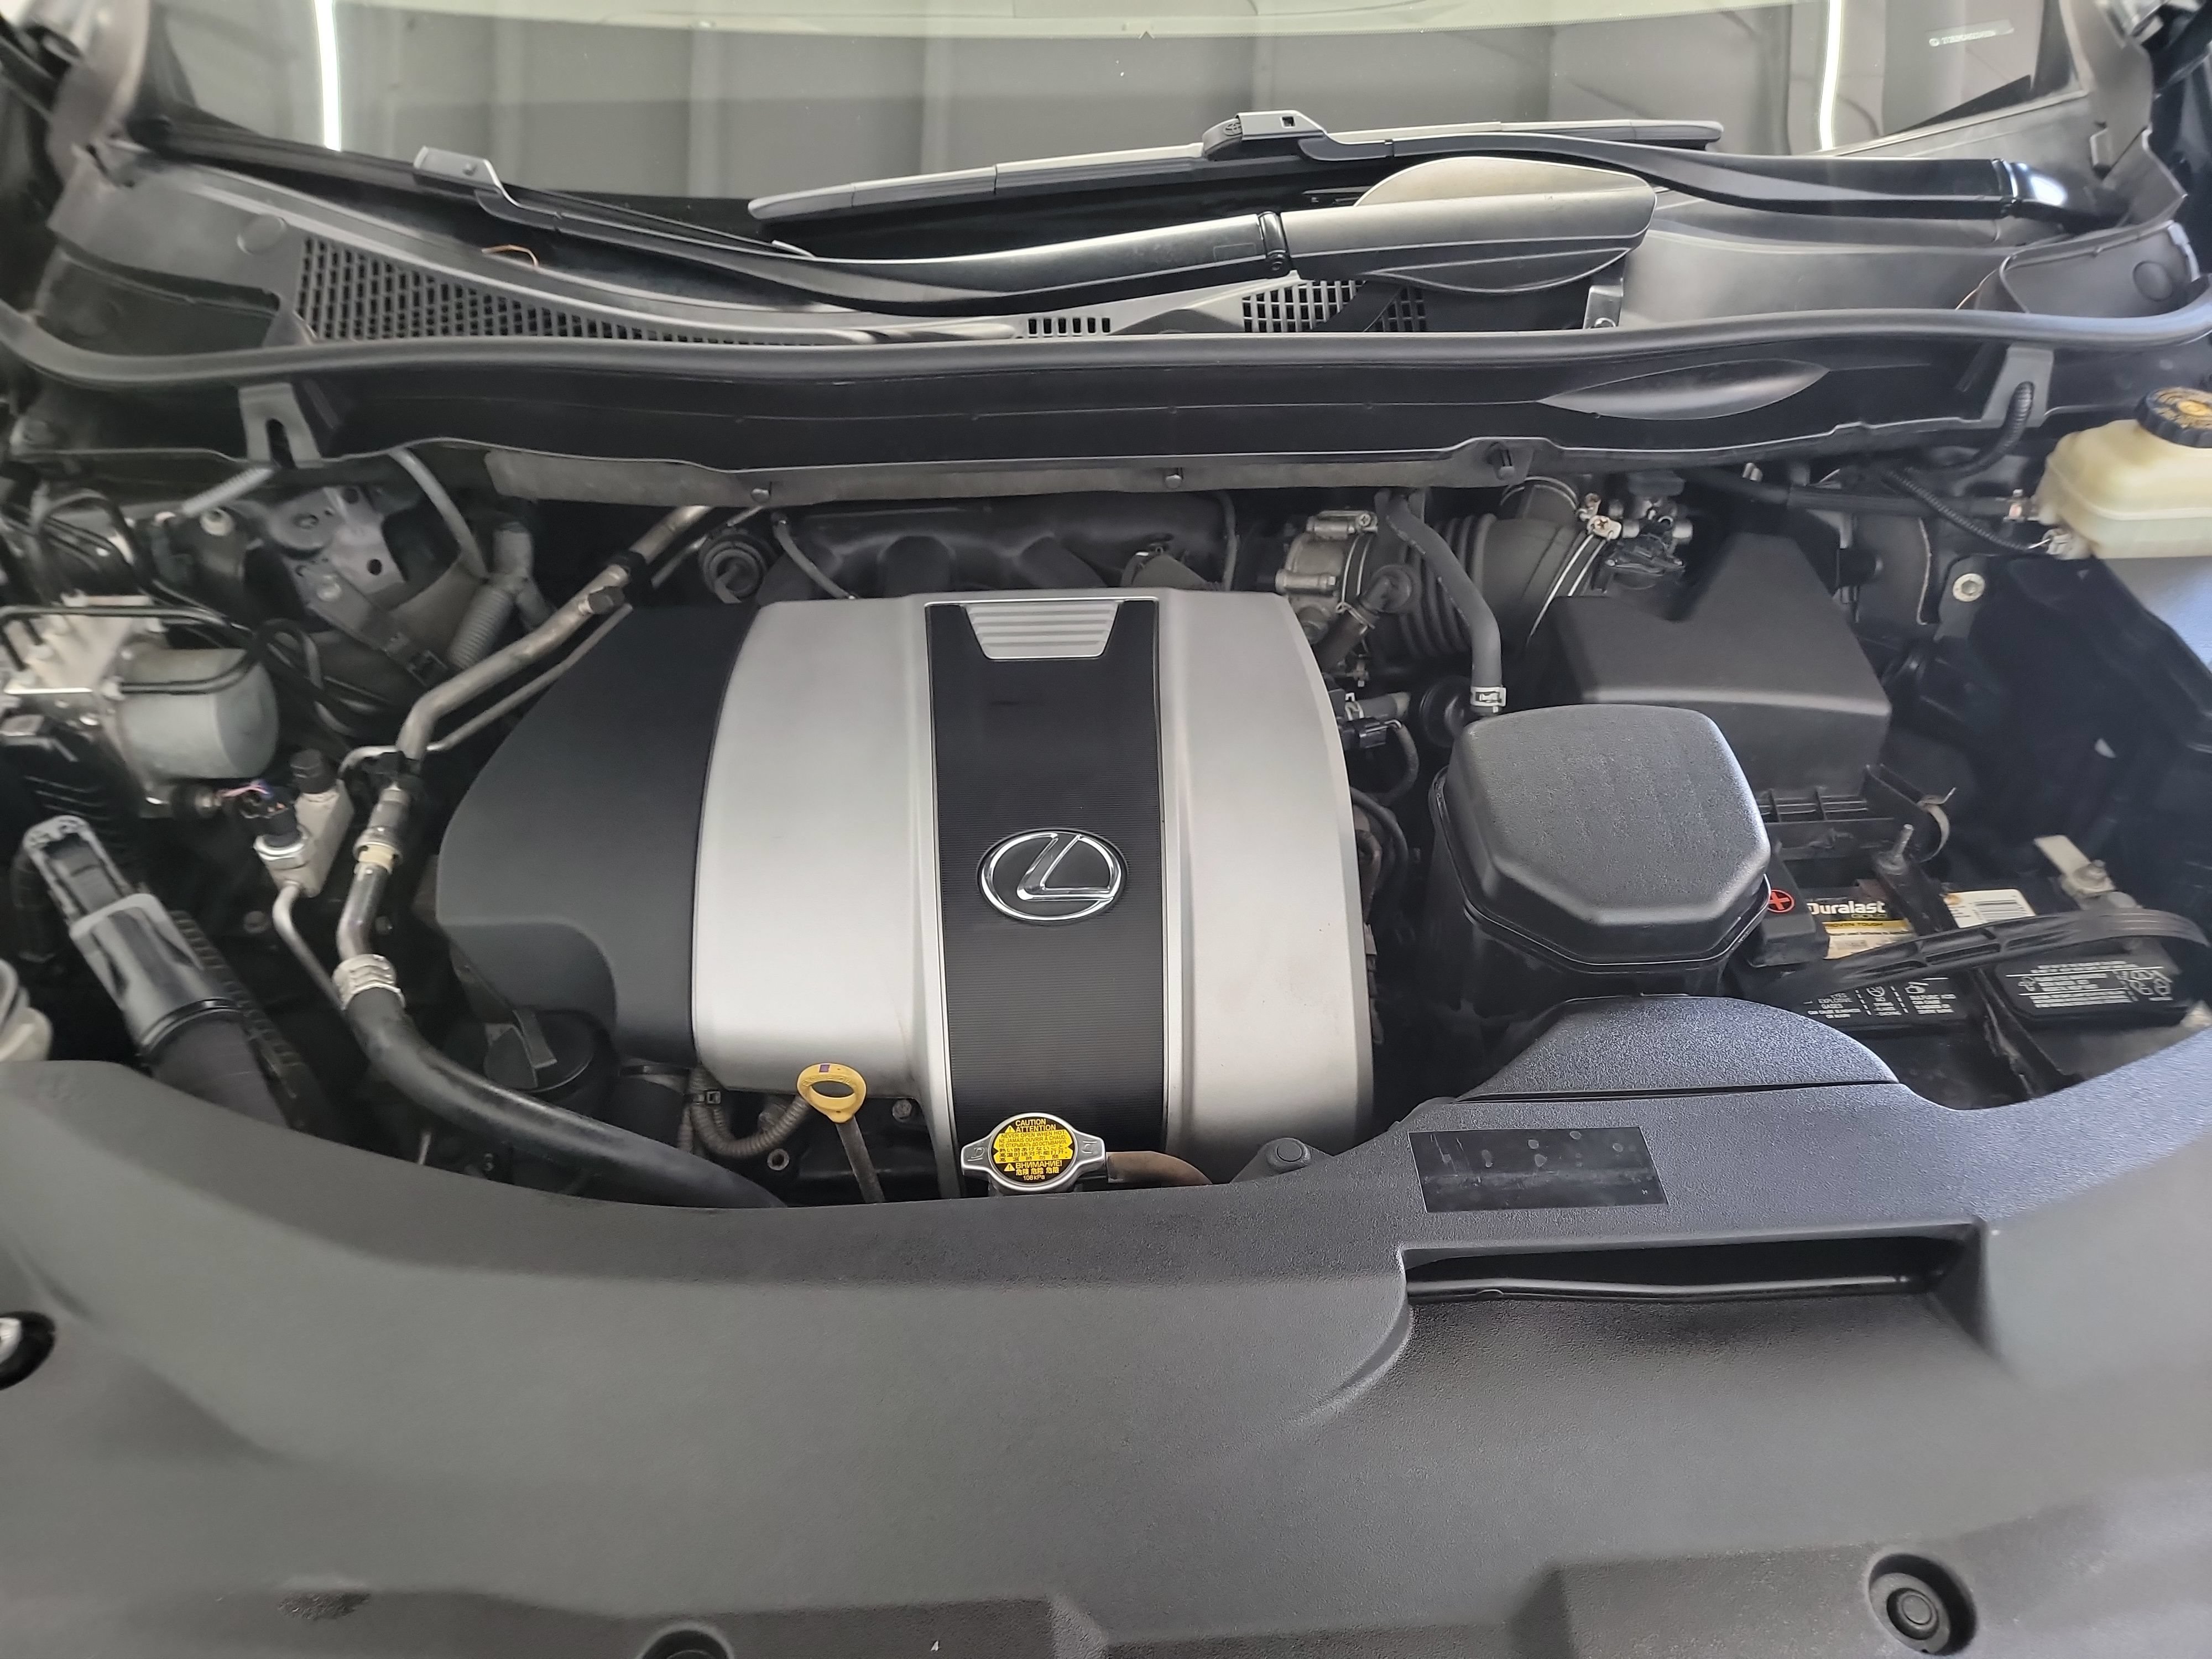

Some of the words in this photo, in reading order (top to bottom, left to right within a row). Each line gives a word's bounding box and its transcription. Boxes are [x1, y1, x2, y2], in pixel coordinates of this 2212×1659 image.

[1807, 900, 1887, 915] Duralast
[1015, 1118, 1046, 1126] CAUTION
[1015, 1124, 1056, 1133] ATTENTION
[1015, 1160, 1062, 1169] ВНИМАНИЕ!
